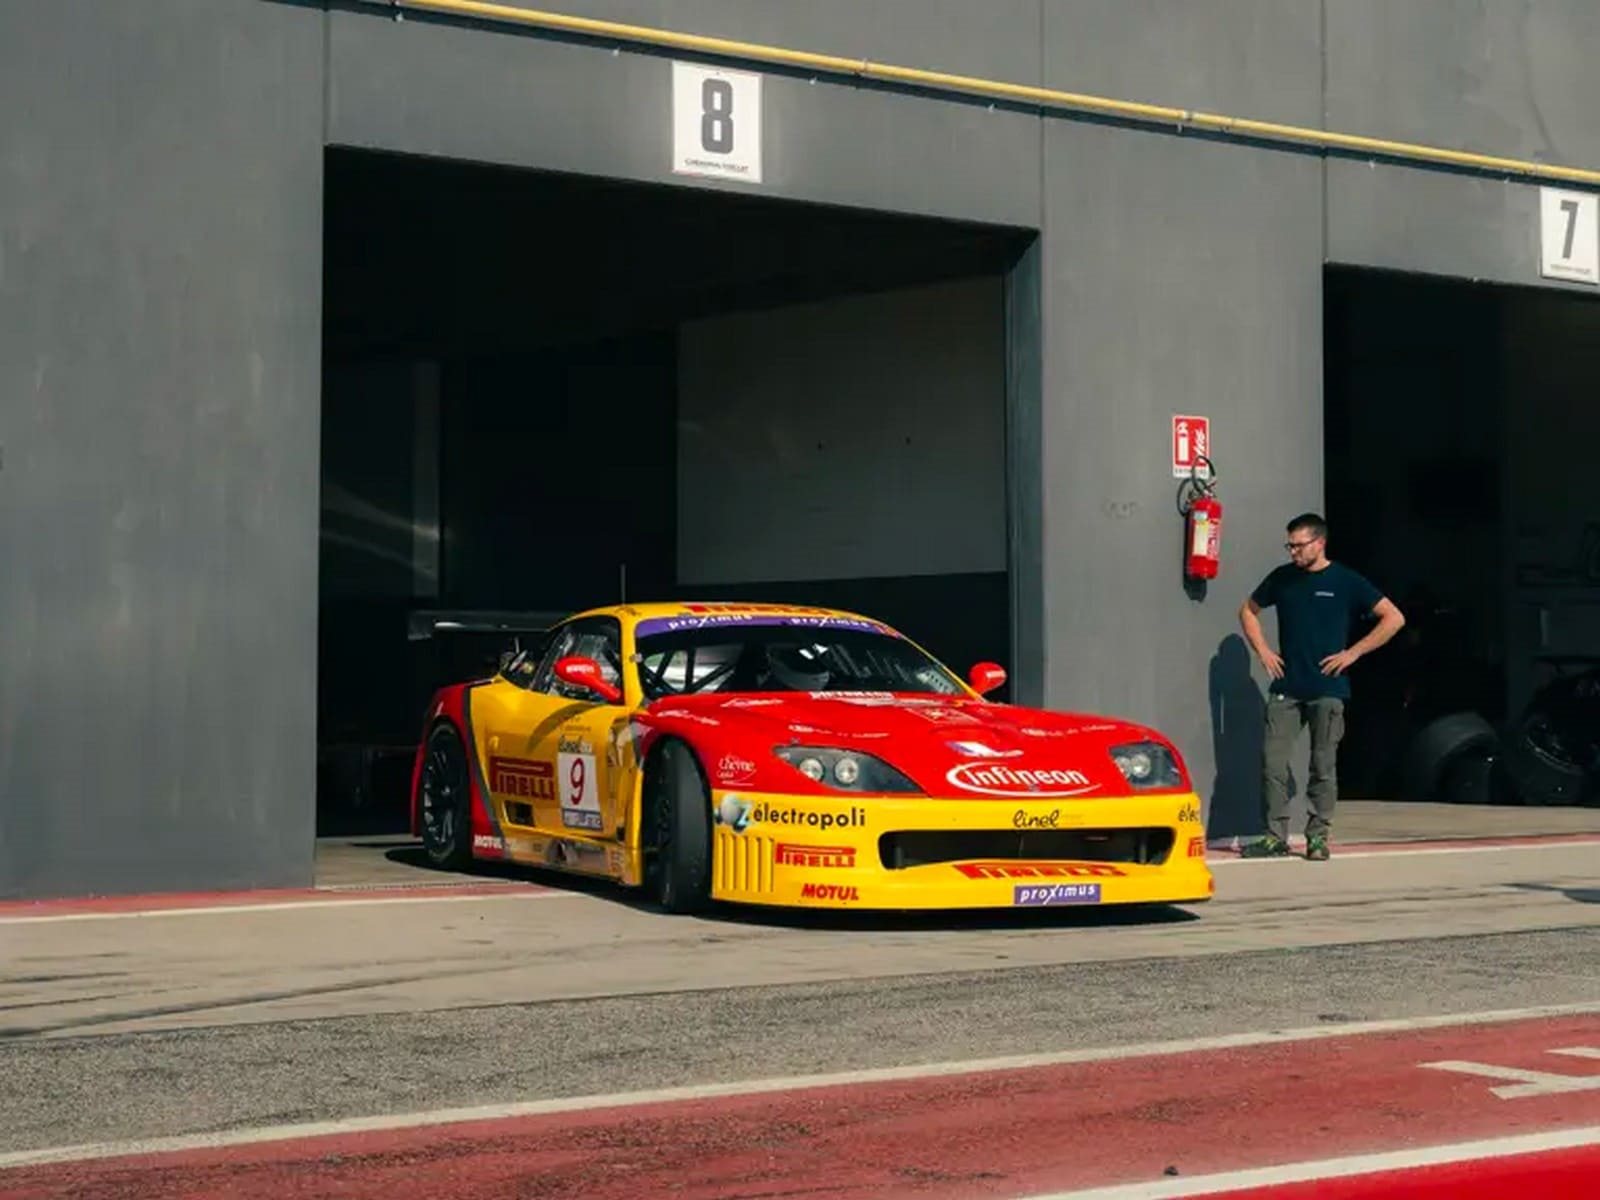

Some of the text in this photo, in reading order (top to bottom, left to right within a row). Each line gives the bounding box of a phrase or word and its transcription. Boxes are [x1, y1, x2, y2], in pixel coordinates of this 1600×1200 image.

[702, 78, 733, 154] 8
[1560, 199, 1578, 258] 7
[489, 755, 555, 801] PIRELLI
[570, 757, 585, 806] 9
[965, 766, 1090, 787] Infineon
[775, 843, 856, 868] PIRELLI
[801, 883, 859, 901] MOTUL
[1020, 884, 1097, 905] proximus
